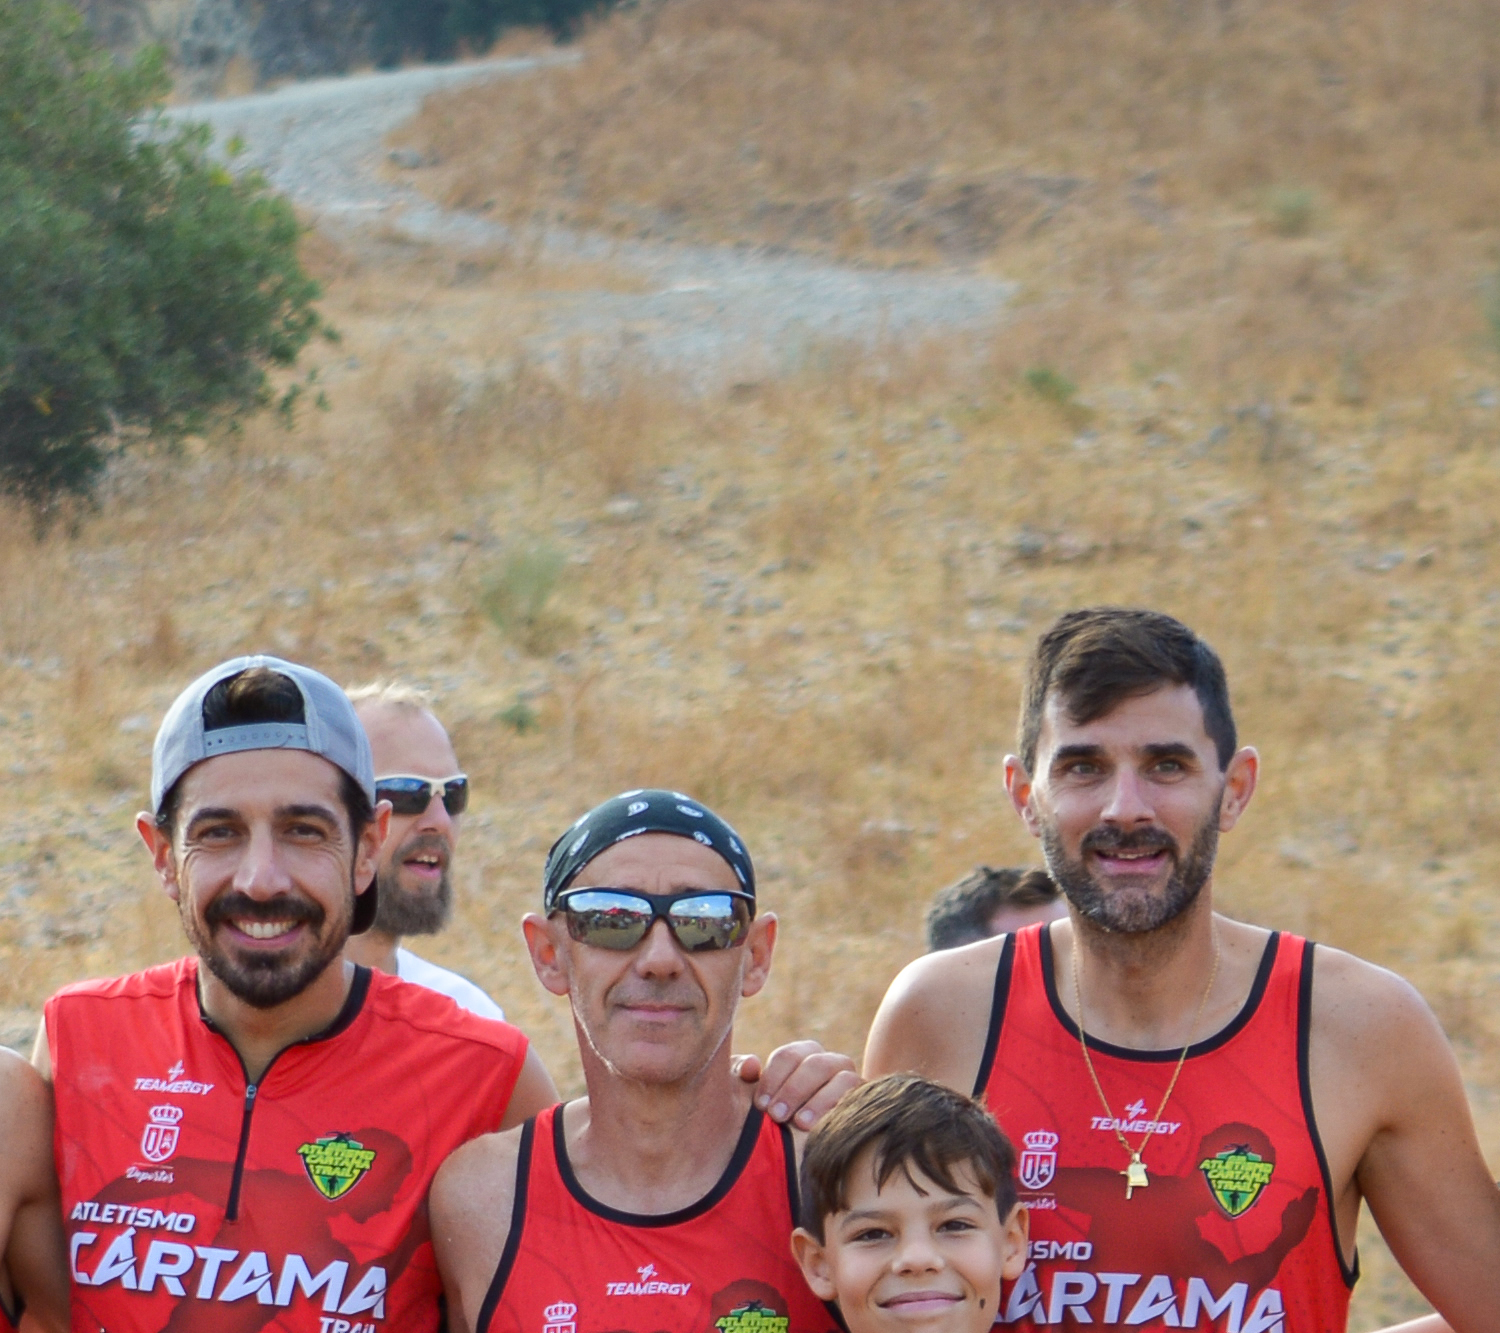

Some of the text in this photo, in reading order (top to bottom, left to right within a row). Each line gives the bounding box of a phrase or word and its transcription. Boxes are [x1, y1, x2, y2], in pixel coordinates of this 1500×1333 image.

[133, 1077, 215, 1096] TEAMERGY
[1091, 1115, 1181, 1135] TEAMERGY
[125, 1165, 175, 1184] Deportes
[71, 1201, 196, 1234] ATLETISMO
[70, 1227, 388, 1319] CÁRTAMA
[606, 1281, 691, 1297] TEAMERGY
